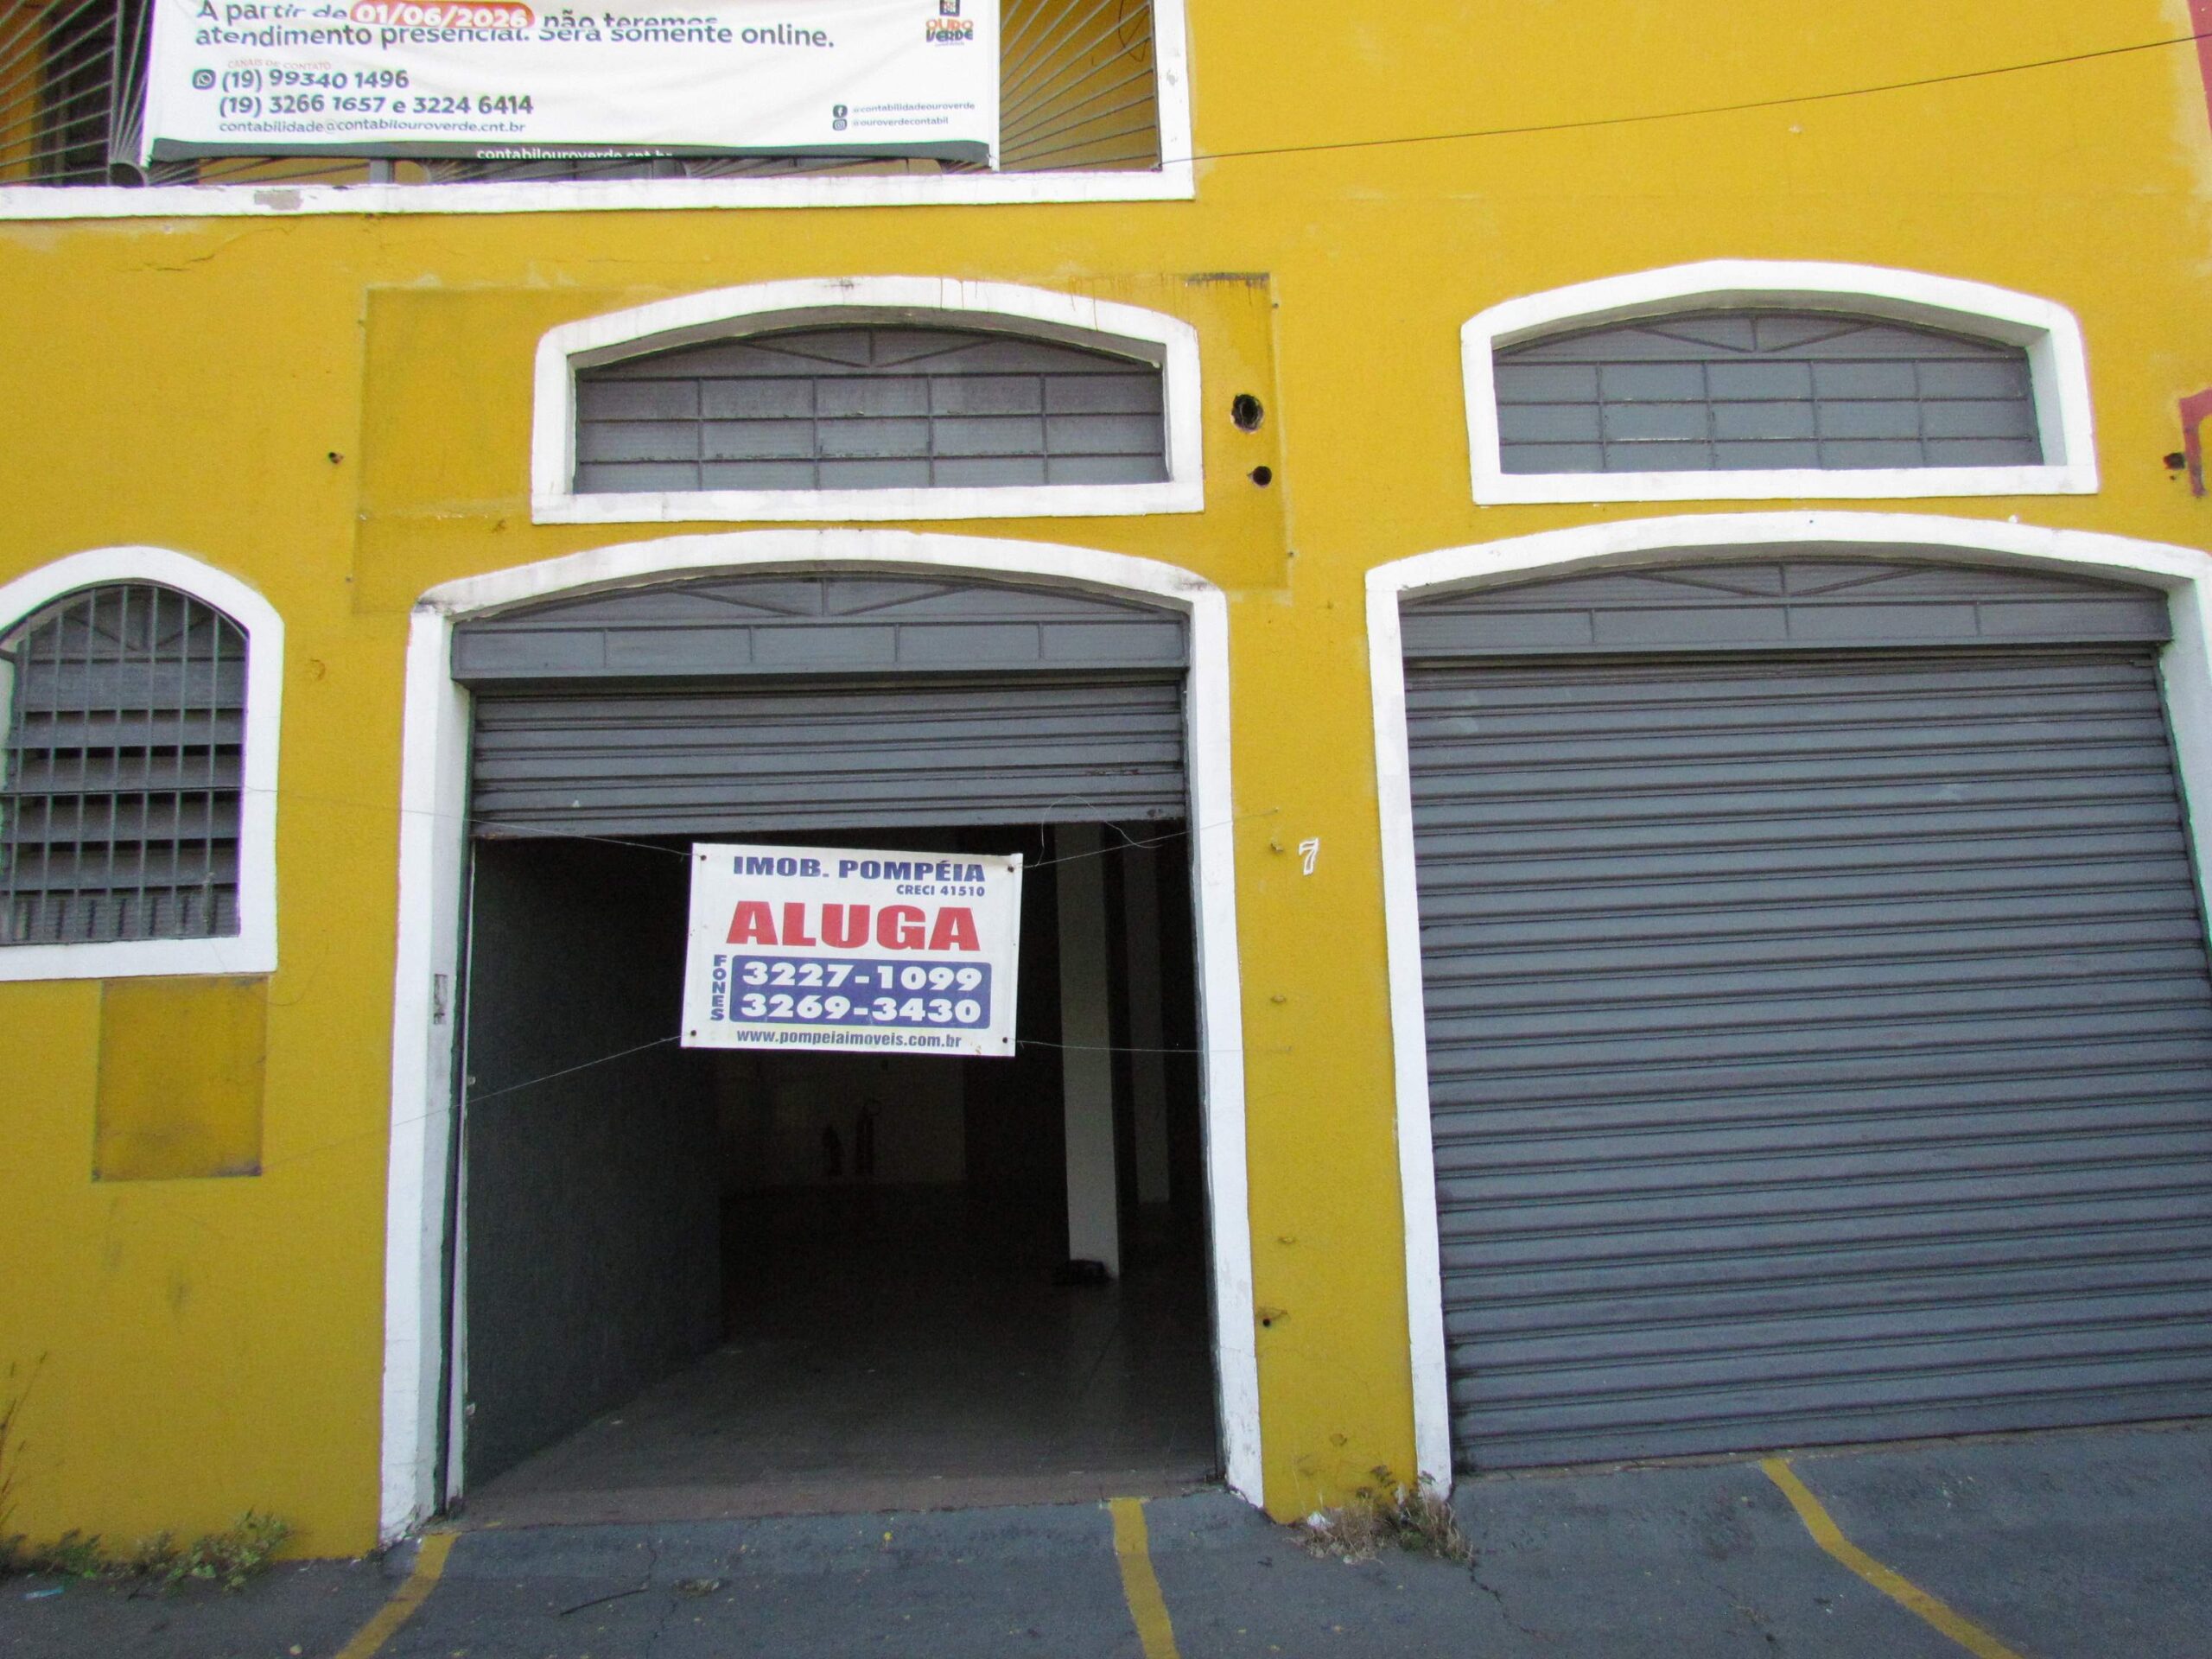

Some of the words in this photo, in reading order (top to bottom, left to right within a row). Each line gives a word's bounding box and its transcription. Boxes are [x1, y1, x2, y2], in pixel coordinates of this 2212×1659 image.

[197, 0, 219, 21] A
[226, 3, 306, 26] partir
[312, 4, 347, 19] de
[543, 10, 595, 28] não
[196, 25, 372, 47] atendimento
[381, 27, 530, 50] presencial.
[610, 25, 733, 42] somente
[741, 23, 834, 47] online.
[925, 29, 974, 42] VERDE
[228, 59, 263, 69] CANAIS
[283, 61, 331, 70] CONTATO
[222, 69, 262, 92] (19)
[269, 69, 347, 89] 99340
[355, 69, 410, 88] 1496
[219, 96, 262, 118] (19)
[269, 94, 325, 113] 3266
[332, 97, 386, 113] 1657
[392, 99, 406, 113] e
[413, 97, 471, 114] 3224
[478, 95, 533, 115] 6414
[219, 117, 526, 134] contabilidade@contabilouroverde.cnt.br
[734, 856, 830, 878] IMOB.
[839, 860, 985, 882] POMPÉIA
[1299, 837, 1319, 875] 7
[896, 884, 935, 896] CRECI
[940, 885, 985, 897] 41510
[726, 900, 981, 951] ALUGA
[710, 955, 727, 1021] FONES
[742, 962, 982, 991] 3227-1099
[741, 994, 981, 1023] 3269-3430
[737, 1029, 962, 1048] www.pompeiaimoveis.com.br
